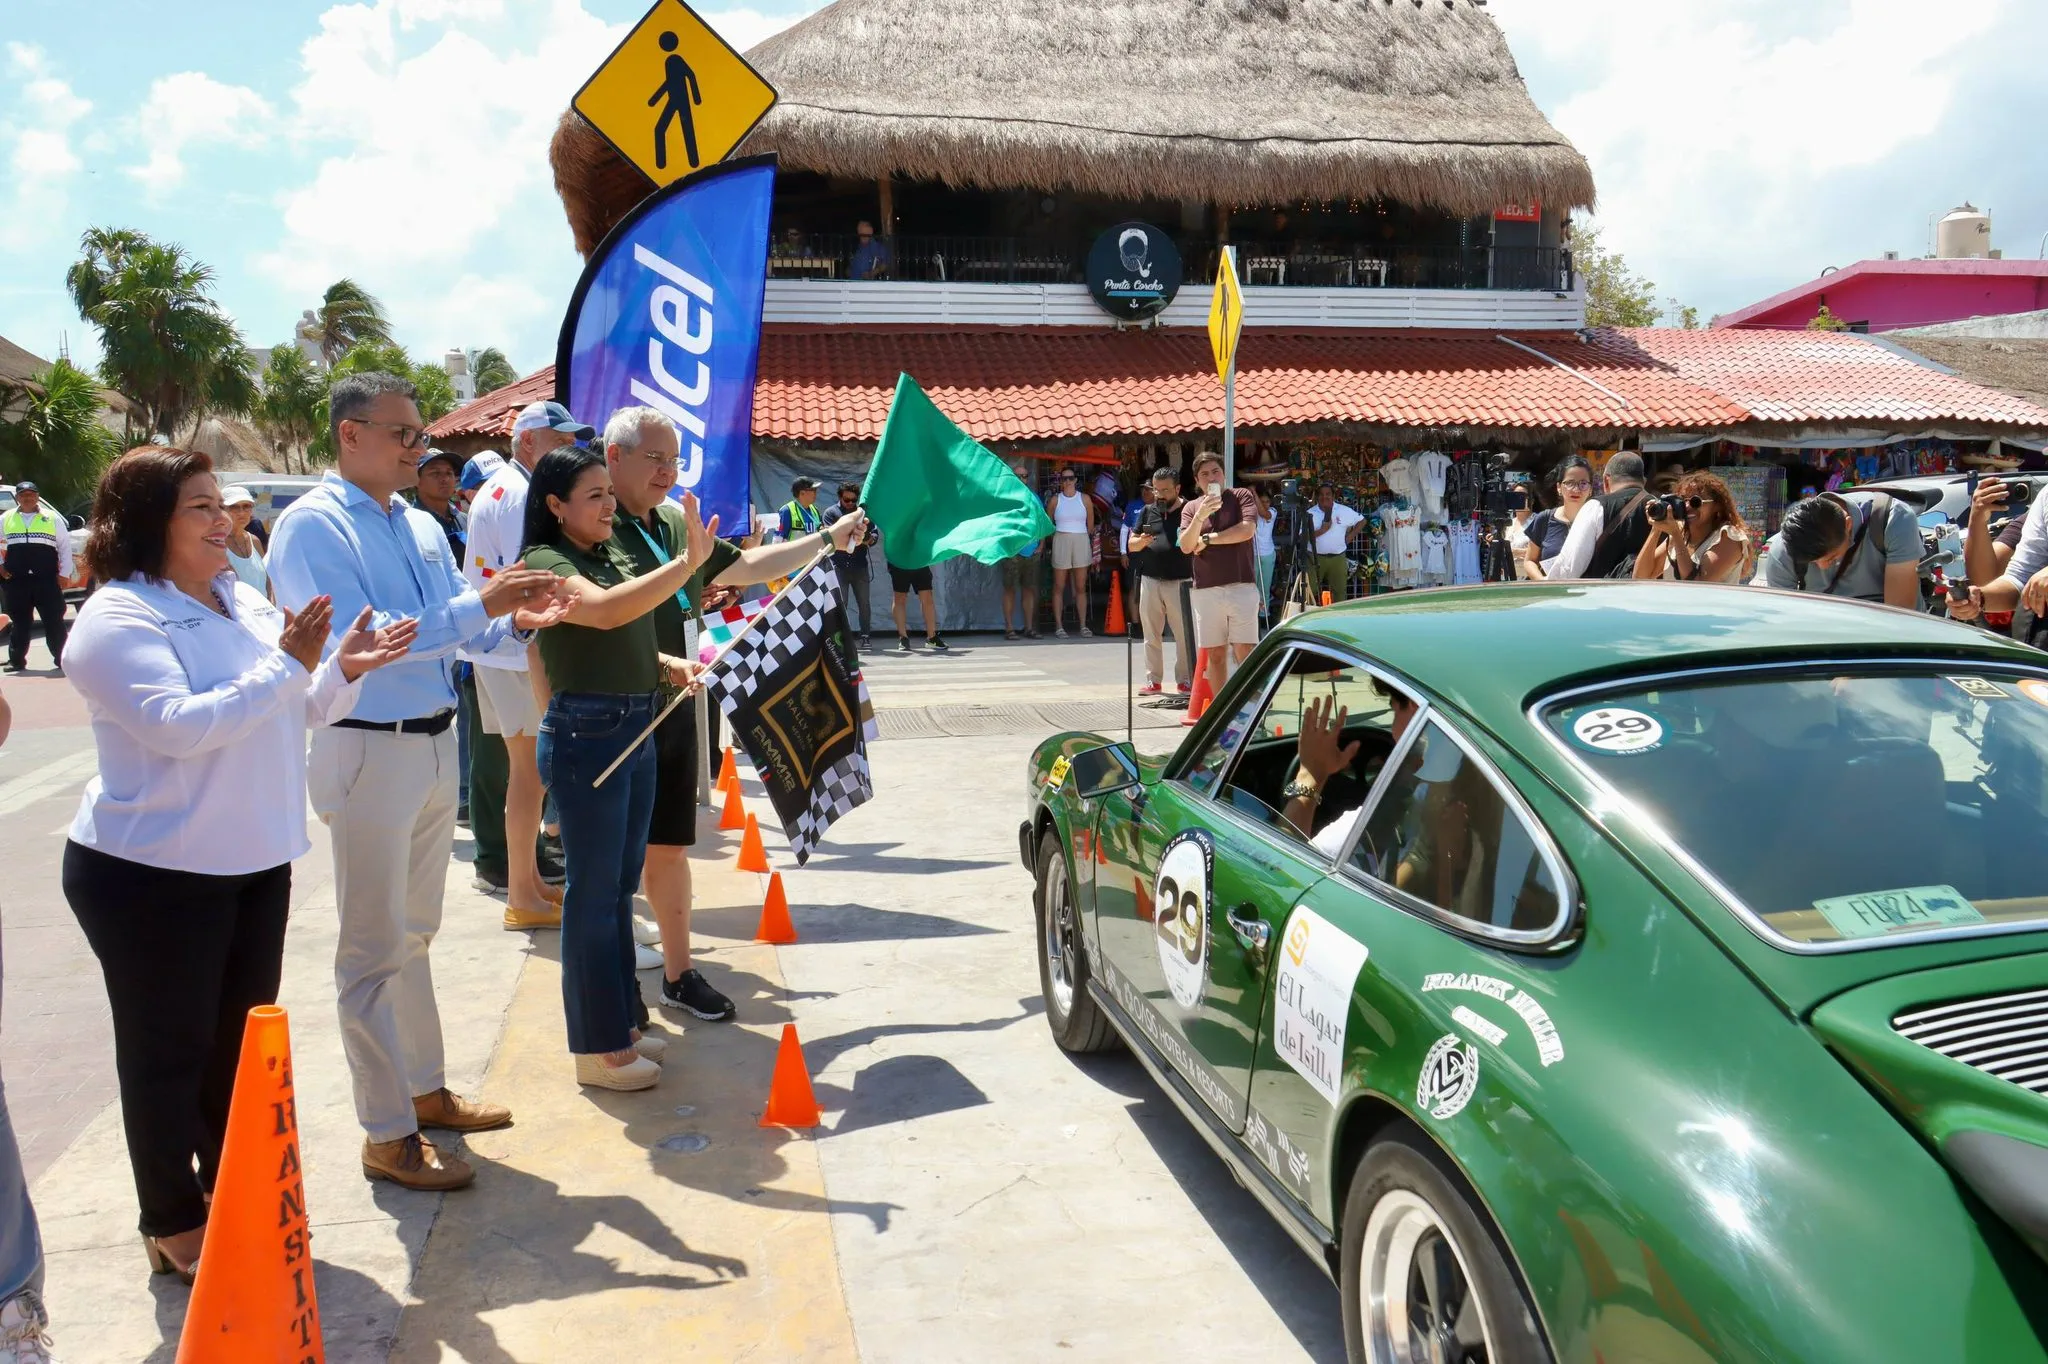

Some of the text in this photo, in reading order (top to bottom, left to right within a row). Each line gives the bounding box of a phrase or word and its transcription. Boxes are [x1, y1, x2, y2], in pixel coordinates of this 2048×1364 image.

[1104, 278, 1164, 291] Punta Corcho
[1583, 717, 1652, 742] 29
[1158, 875, 1203, 966] 29
[1279, 971, 1295, 1007] El
[1279, 1019, 1297, 1053] de
[1158, 1023, 1189, 1070] HOTELS
[1194, 1064, 1236, 1121] RESORTS
